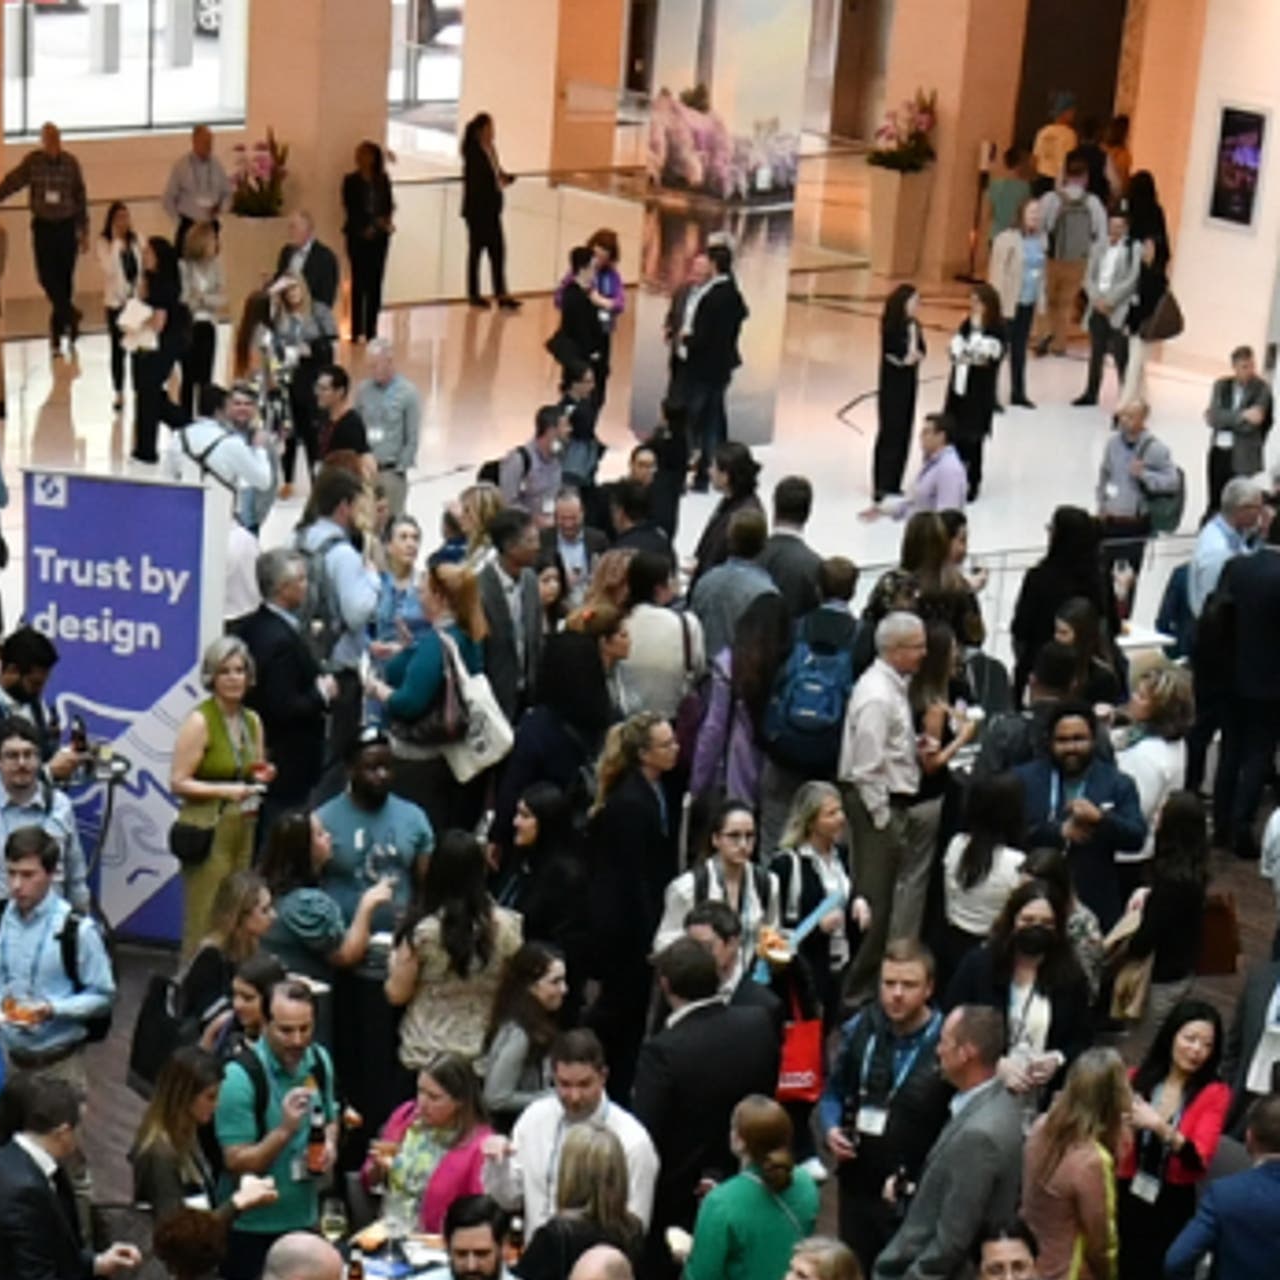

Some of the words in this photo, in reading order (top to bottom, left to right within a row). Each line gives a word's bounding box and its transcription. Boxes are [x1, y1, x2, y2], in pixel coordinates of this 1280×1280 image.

[33, 547, 132, 590] Trust
[141, 555, 190, 604] by
[33, 602, 161, 655] design
